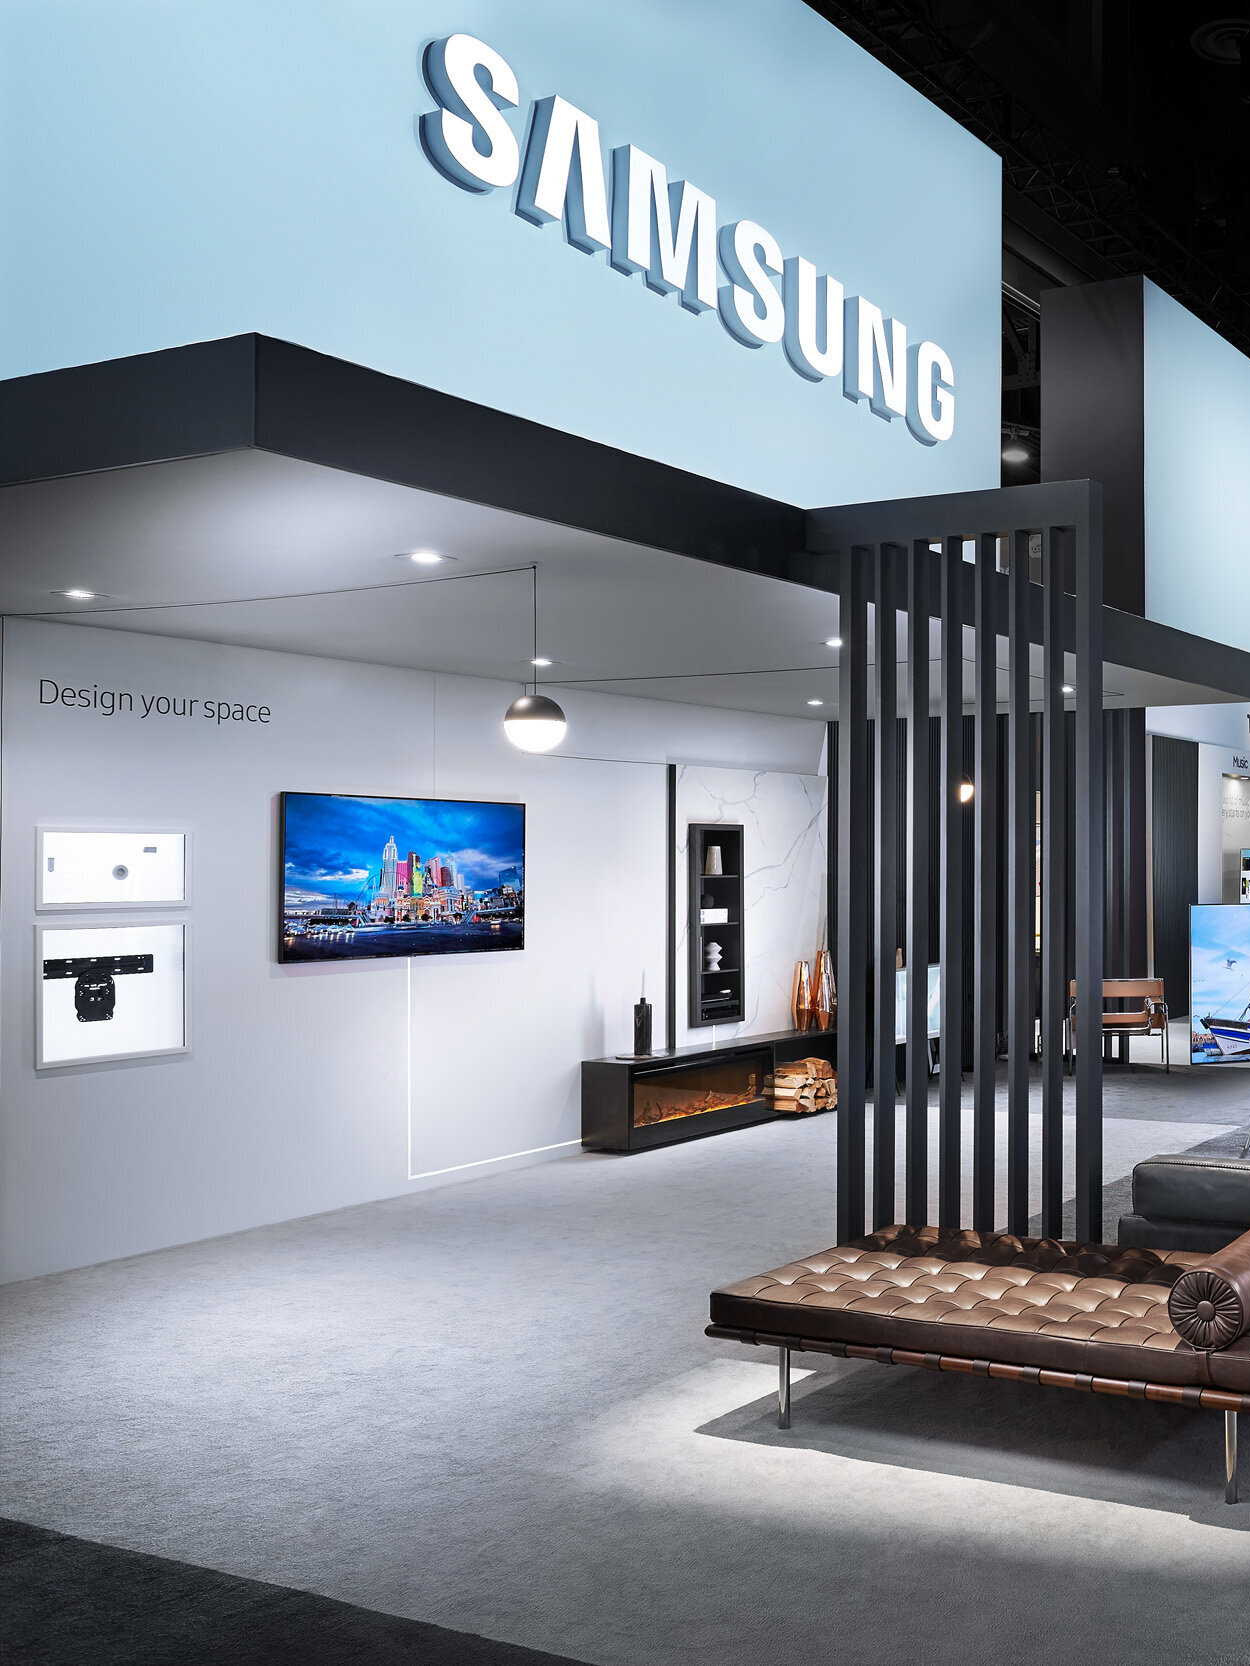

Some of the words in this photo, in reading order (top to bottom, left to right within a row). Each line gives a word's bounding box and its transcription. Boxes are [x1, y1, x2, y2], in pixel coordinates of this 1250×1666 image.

[420, 32, 955, 446] SAMSUNG
[39, 678, 133, 716] Design
[140, 694, 198, 719] your
[203, 699, 271, 725] space
[1232, 756, 1249, 770] Music
